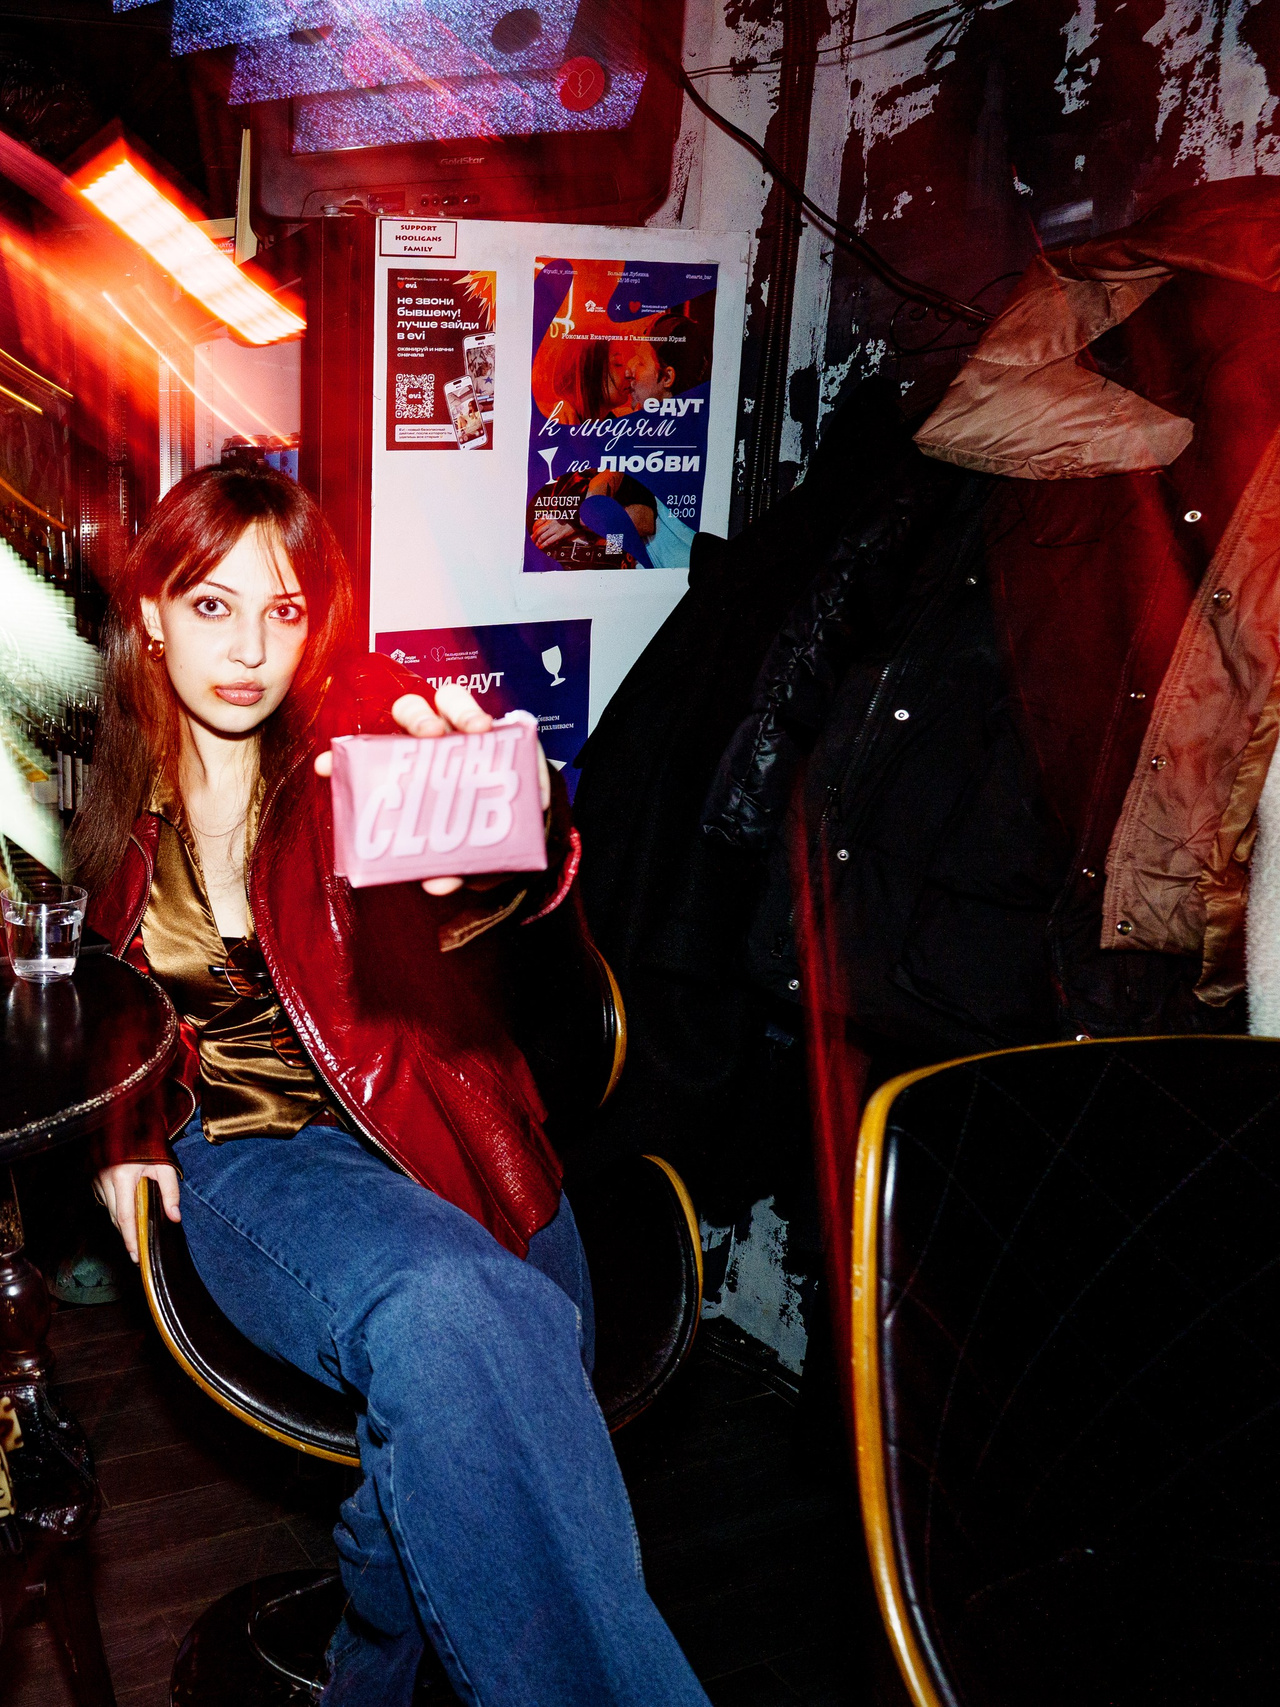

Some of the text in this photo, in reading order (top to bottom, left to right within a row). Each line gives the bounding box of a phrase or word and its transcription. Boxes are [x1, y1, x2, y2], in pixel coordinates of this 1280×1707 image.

[440, 156, 484, 165] GoldStar
[395, 234, 442, 242] HOOLIGANS
[405, 281, 418, 289] evi
[397, 297, 454, 306] не звони
[397, 307, 461, 320] бывшему!
[396, 319, 479, 331] лучше зайди
[396, 330, 426, 340] в evi
[590, 333, 623, 342] Екатерина
[668, 335, 687, 343] Юрий
[408, 391, 422, 399] evi
[643, 397, 705, 417] едут
[538, 400, 677, 452] к людям
[566, 450, 701, 473] по любви
[534, 496, 581, 507] AUGUST
[666, 494, 697, 508] 21/08
[533, 509, 577, 521] FRIDAY
[667, 507, 696, 518] 19:00
[456, 671, 505, 694] едут
[388, 727, 523, 790] FIGHT
[355, 771, 520, 861] CLUB
